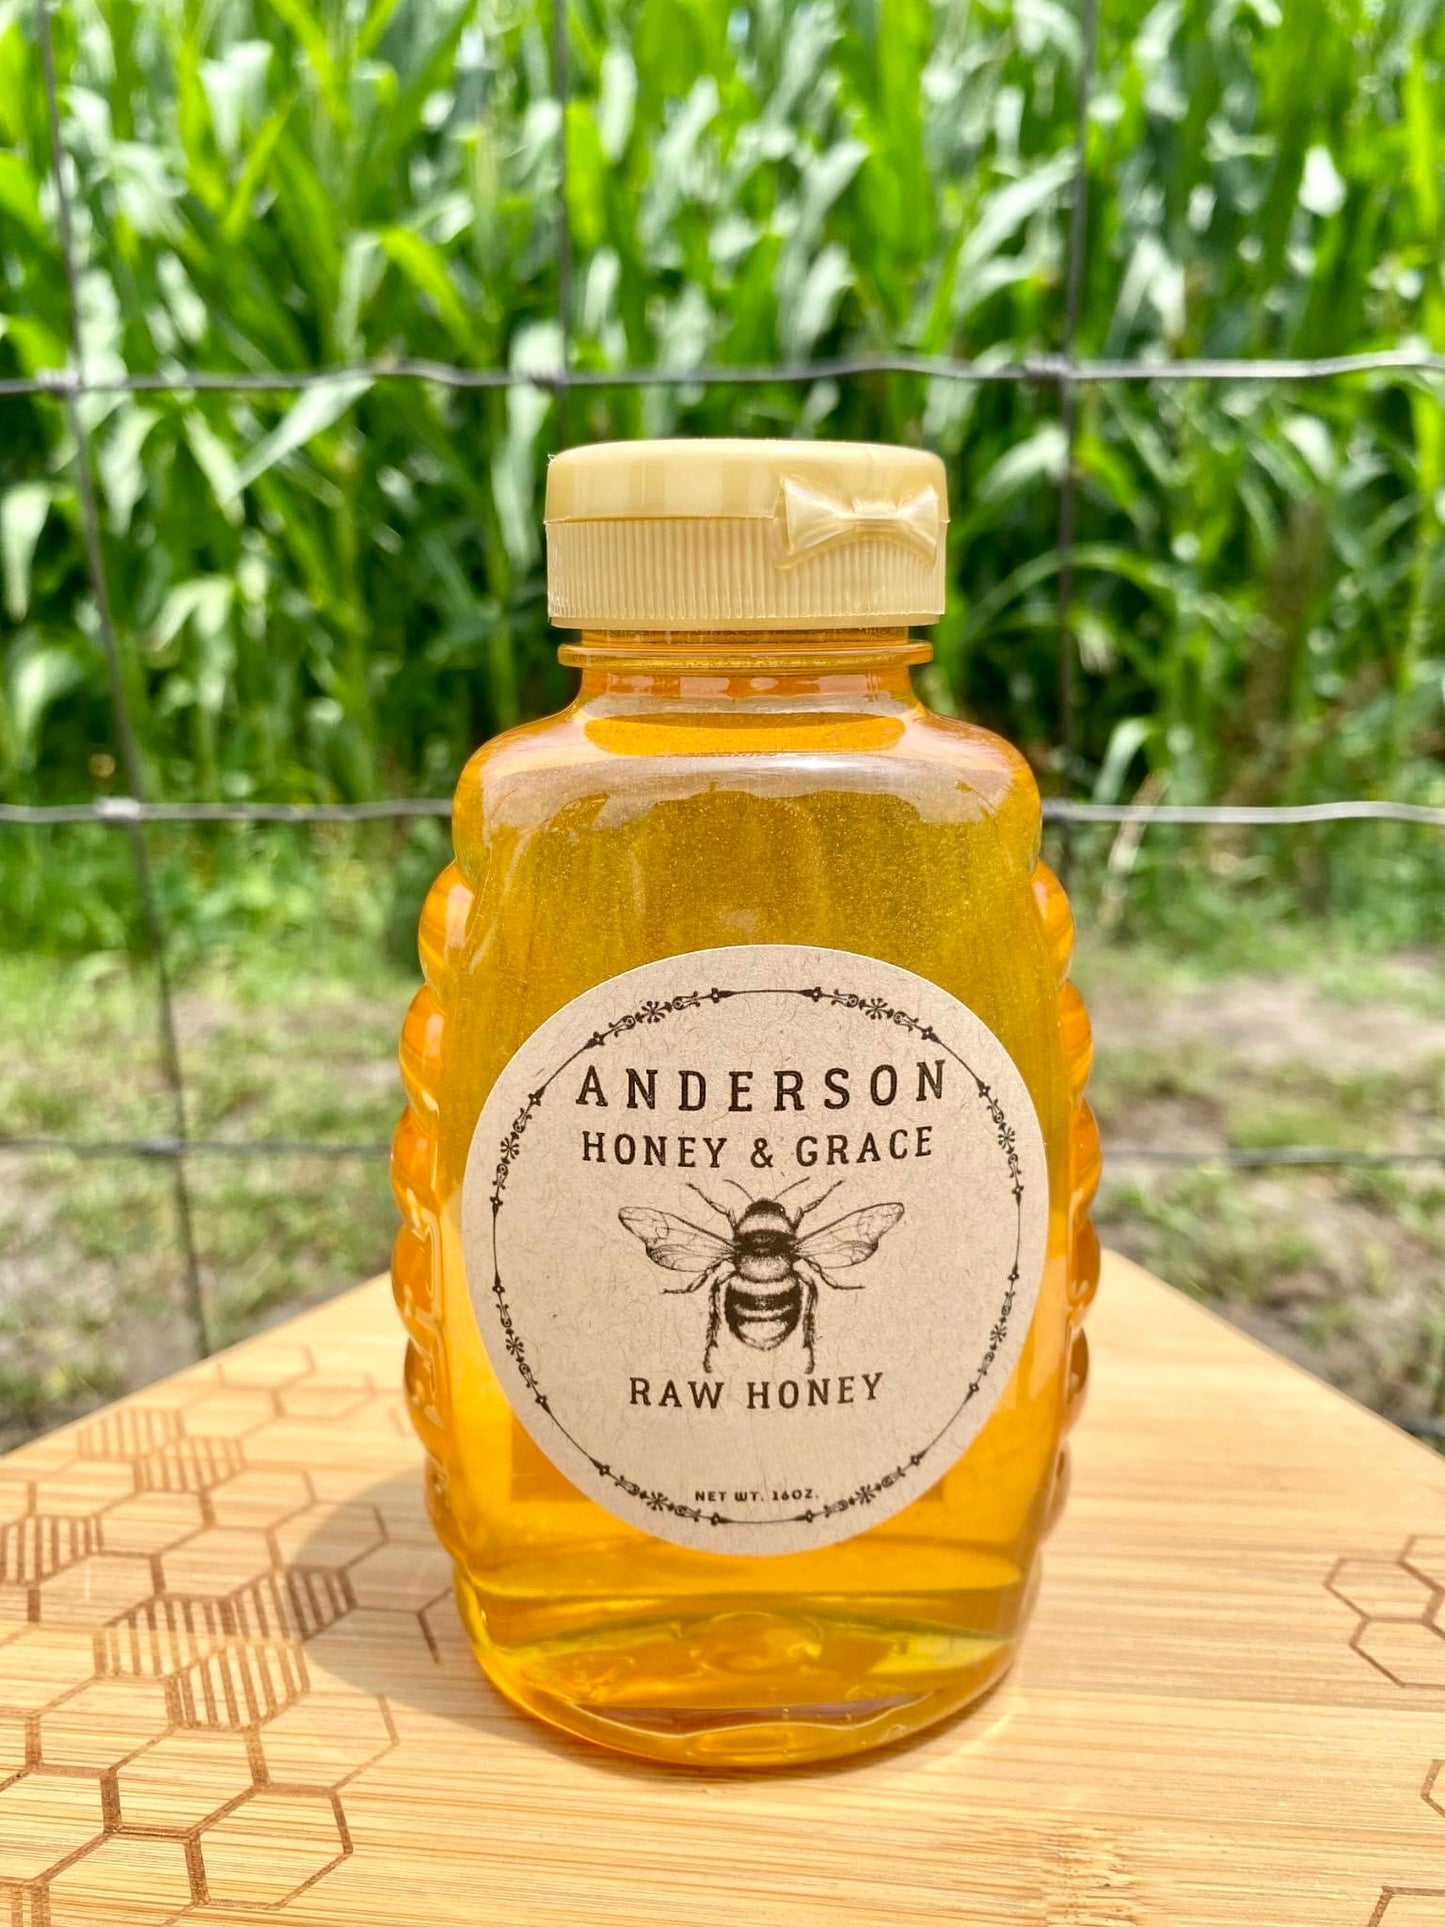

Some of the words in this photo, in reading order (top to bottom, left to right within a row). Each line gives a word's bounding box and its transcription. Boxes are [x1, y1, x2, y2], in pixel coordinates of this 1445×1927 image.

[575, 1058, 947, 1113] ANDERSON
[580, 1130, 728, 1169] HONEY
[750, 1137, 774, 1169] &
[795, 1125, 934, 1168] GRACE
[629, 1376, 725, 1410] RAW
[746, 1371, 884, 1410] HONEY
[694, 1490, 726, 1502] NET
[734, 1490, 764, 1502] WT.
